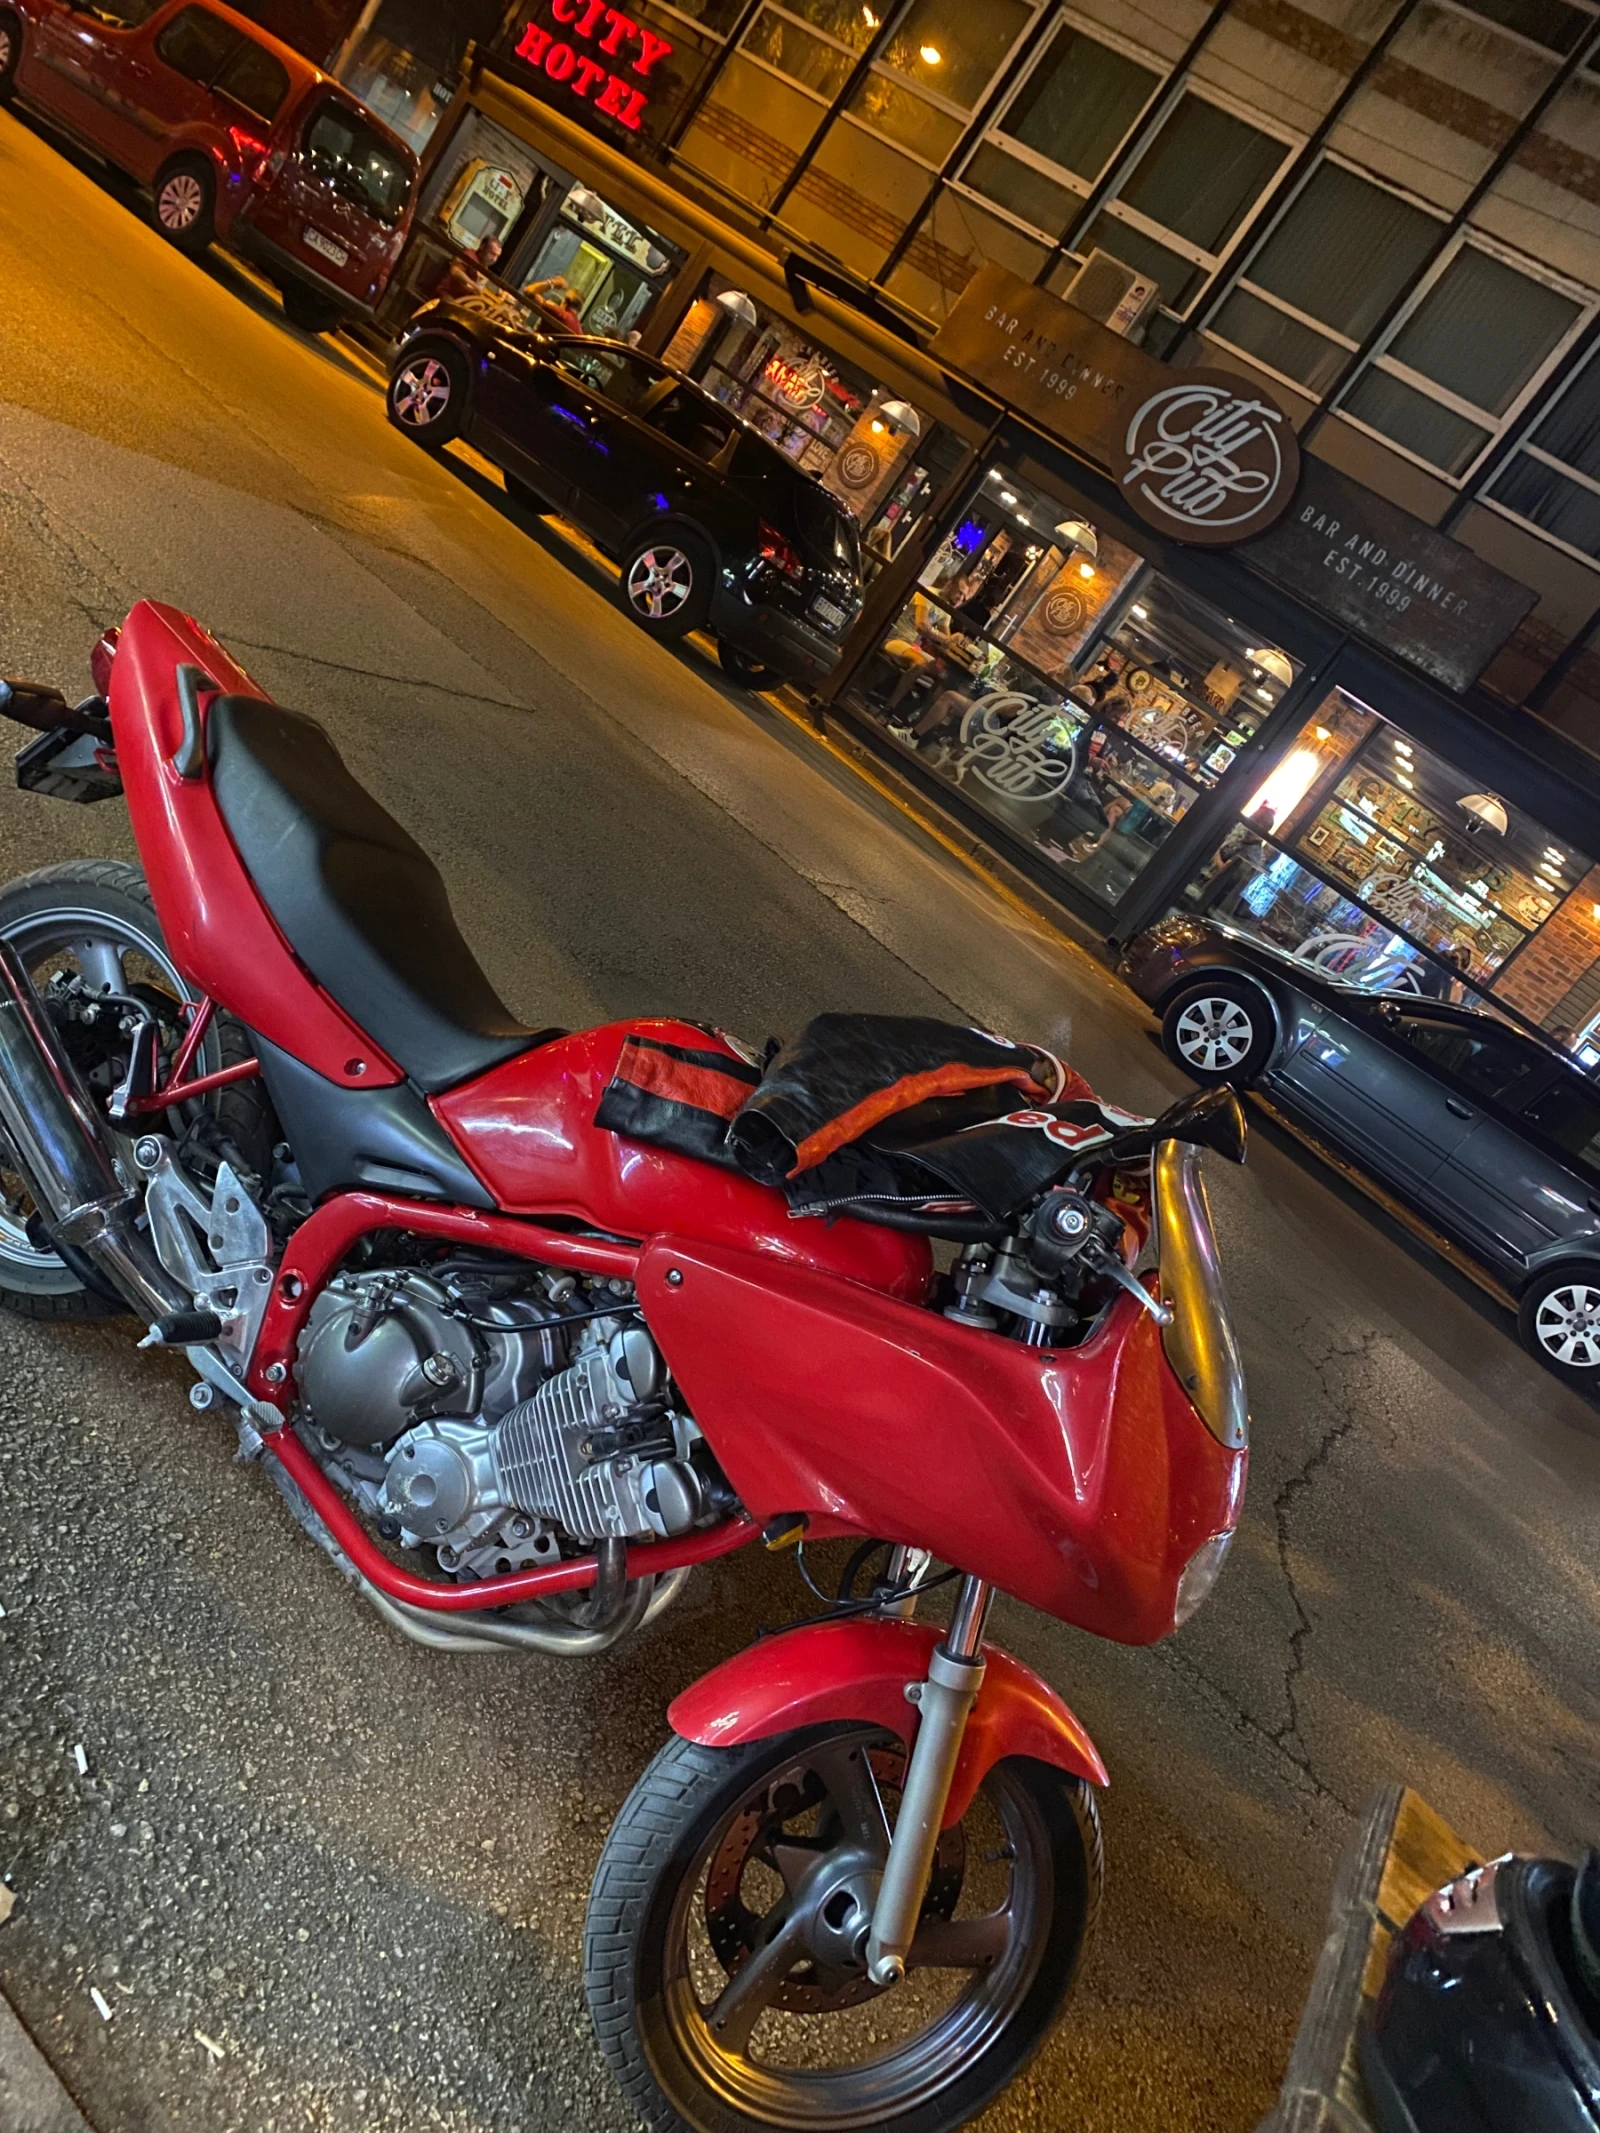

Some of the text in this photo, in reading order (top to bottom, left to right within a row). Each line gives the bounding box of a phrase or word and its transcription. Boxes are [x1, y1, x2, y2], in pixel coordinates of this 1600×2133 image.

[552, 0, 673, 75] CITY
[514, 22, 648, 130] HOTEL
[984, 305, 1018, 335] BAR
[1157, 393, 1282, 470] City
[1123, 441, 1270, 516] Pub
[1300, 505, 1468, 616] BAR AND DINNER
[983, 697, 1076, 755] City
[1181, 707, 1205, 738] BEER
[960, 733, 1068, 792] Pub
